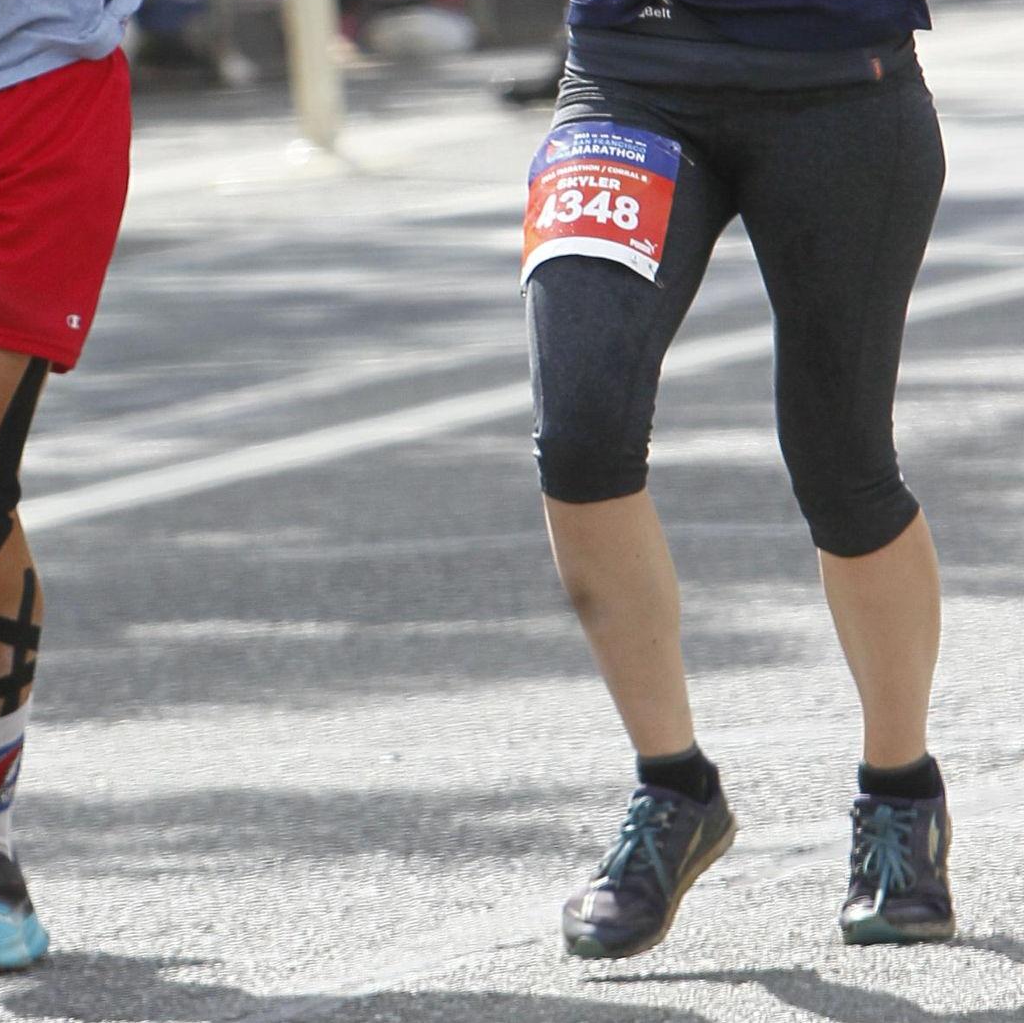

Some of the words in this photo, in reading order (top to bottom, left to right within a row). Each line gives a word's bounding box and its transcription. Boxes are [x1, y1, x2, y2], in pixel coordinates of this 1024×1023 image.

[638, 6, 672, 19] Belt
[571, 144, 646, 163] MARATHON
[593, 138, 647, 154] FRANCISCO
[557, 165, 600, 177] MARATHON
[607, 166, 639, 180] CORRAL
[556, 176, 621, 191] SKYLER
[535, 189, 640, 231] 4348
